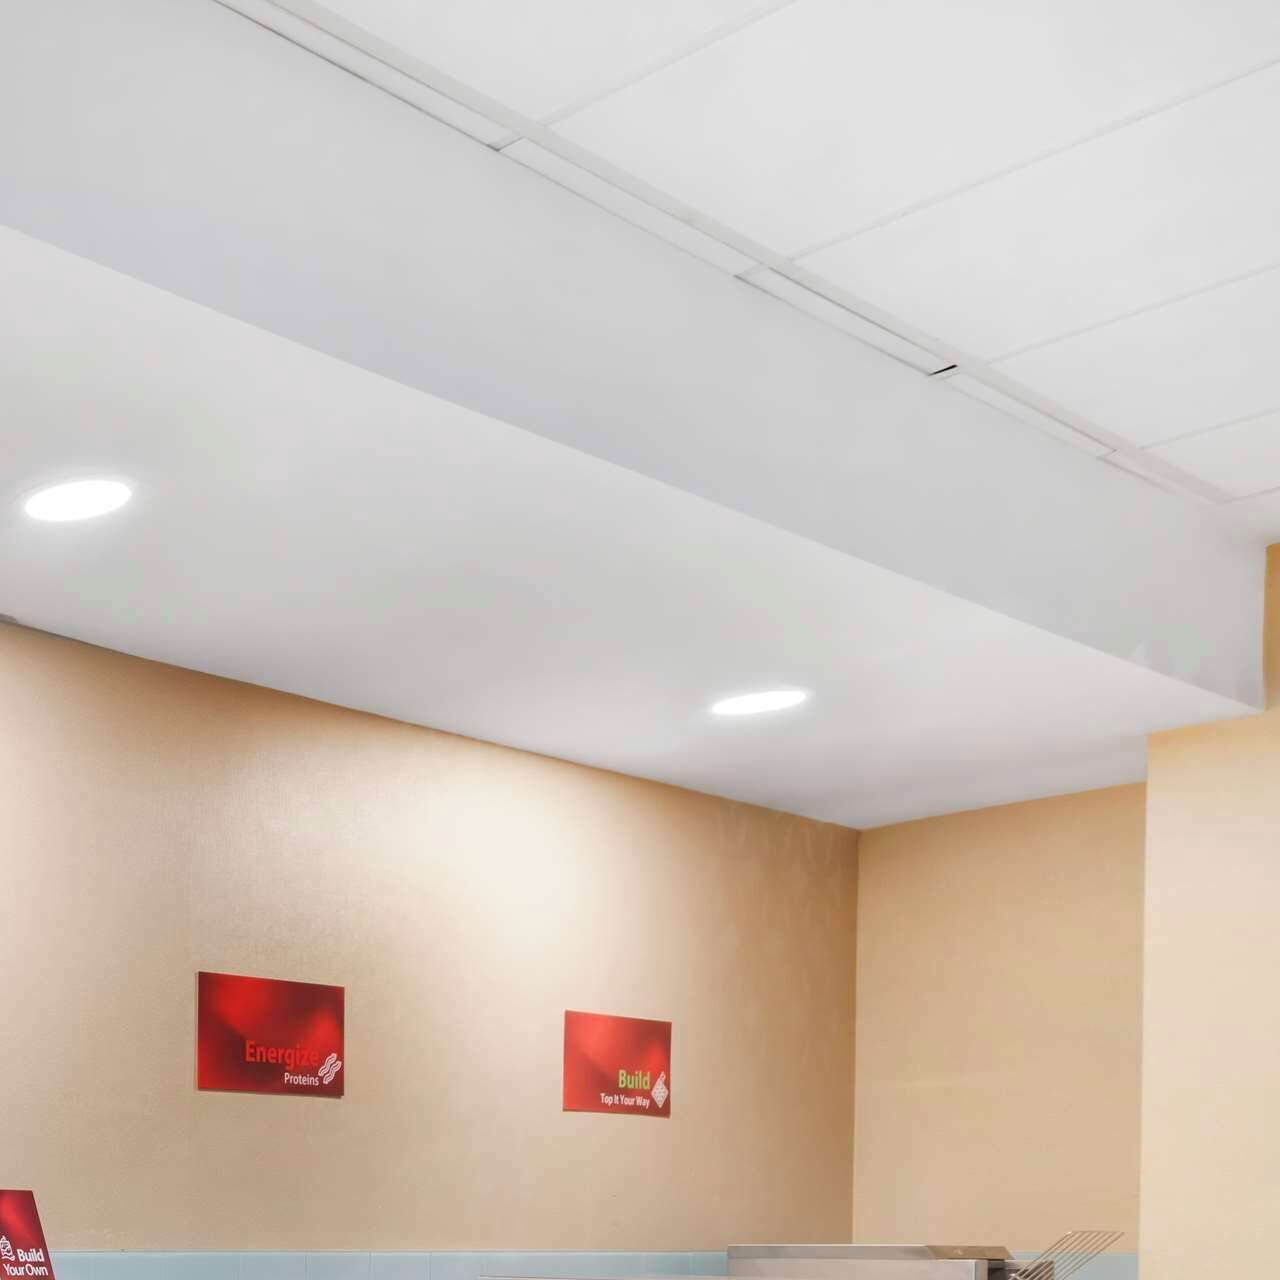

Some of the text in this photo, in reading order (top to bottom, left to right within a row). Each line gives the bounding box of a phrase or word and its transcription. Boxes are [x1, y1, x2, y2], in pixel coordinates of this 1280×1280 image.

[245, 1039, 319, 1071] Energize
[284, 1072, 320, 1086] Proteins
[618, 1069, 651, 1090] Build
[599, 1092, 613, 1107] Top
[619, 1094, 635, 1106] Your
[635, 1095, 651, 1110] Way
[16, 1248, 45, 1262] Build
[3, 1263, 49, 1276] Your Own
